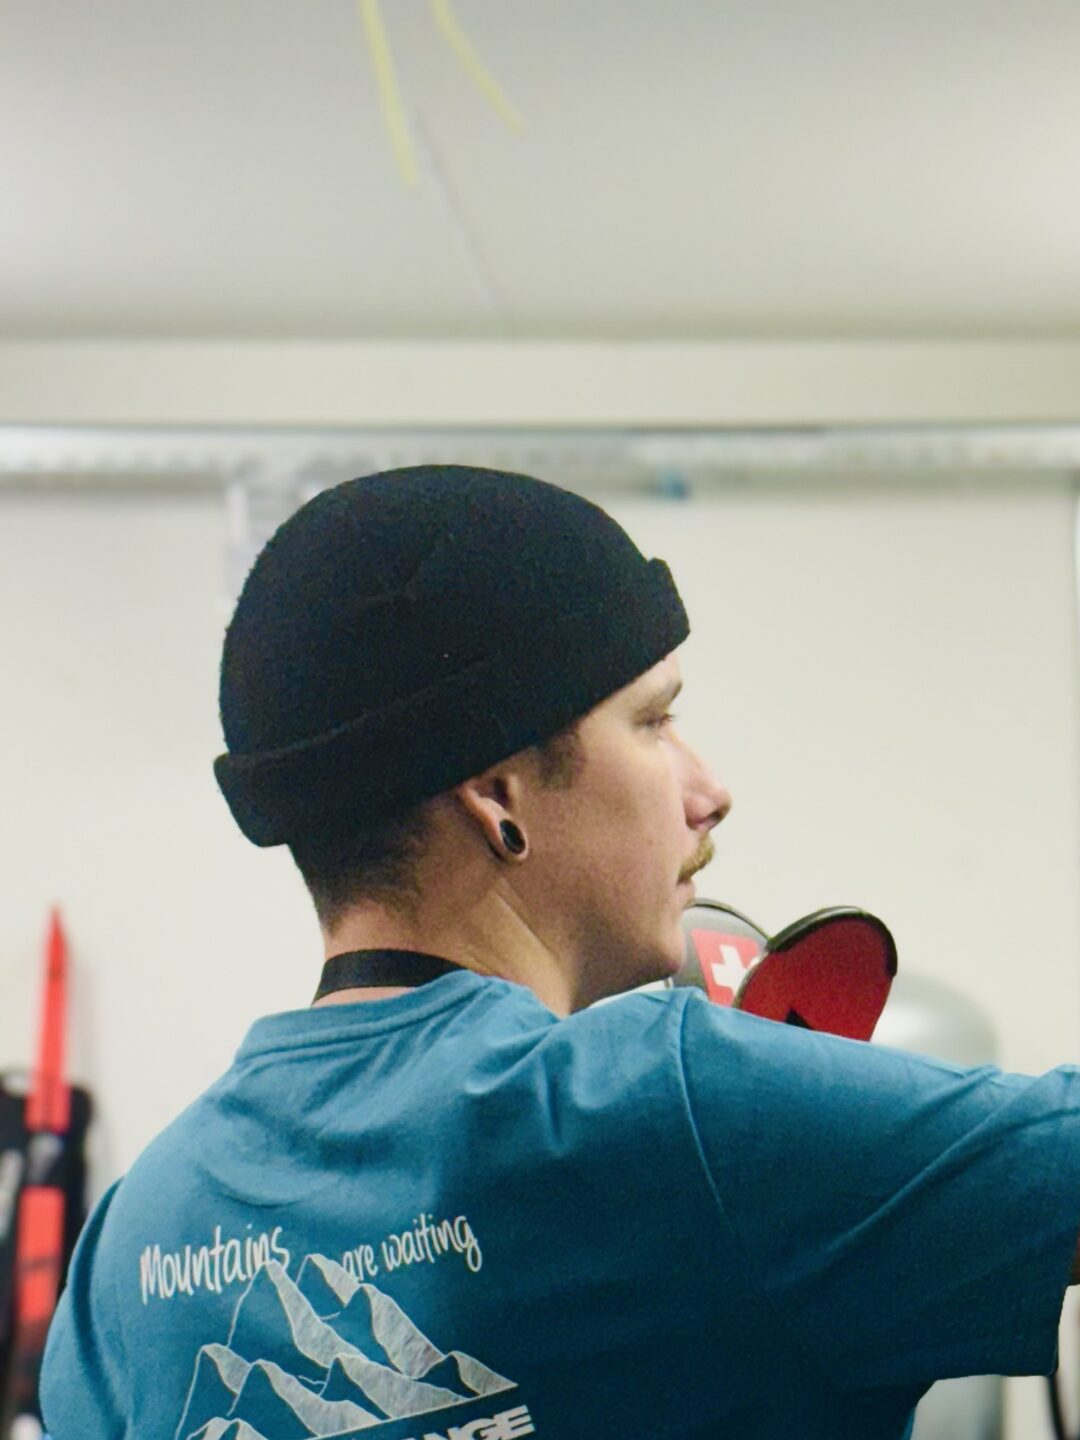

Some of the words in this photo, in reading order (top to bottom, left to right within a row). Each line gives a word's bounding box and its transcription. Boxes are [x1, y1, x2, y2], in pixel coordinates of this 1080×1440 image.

[140, 1224, 290, 1306] Mountains
[342, 1244, 379, 1284] are
[381, 1212, 483, 1273] waiting
